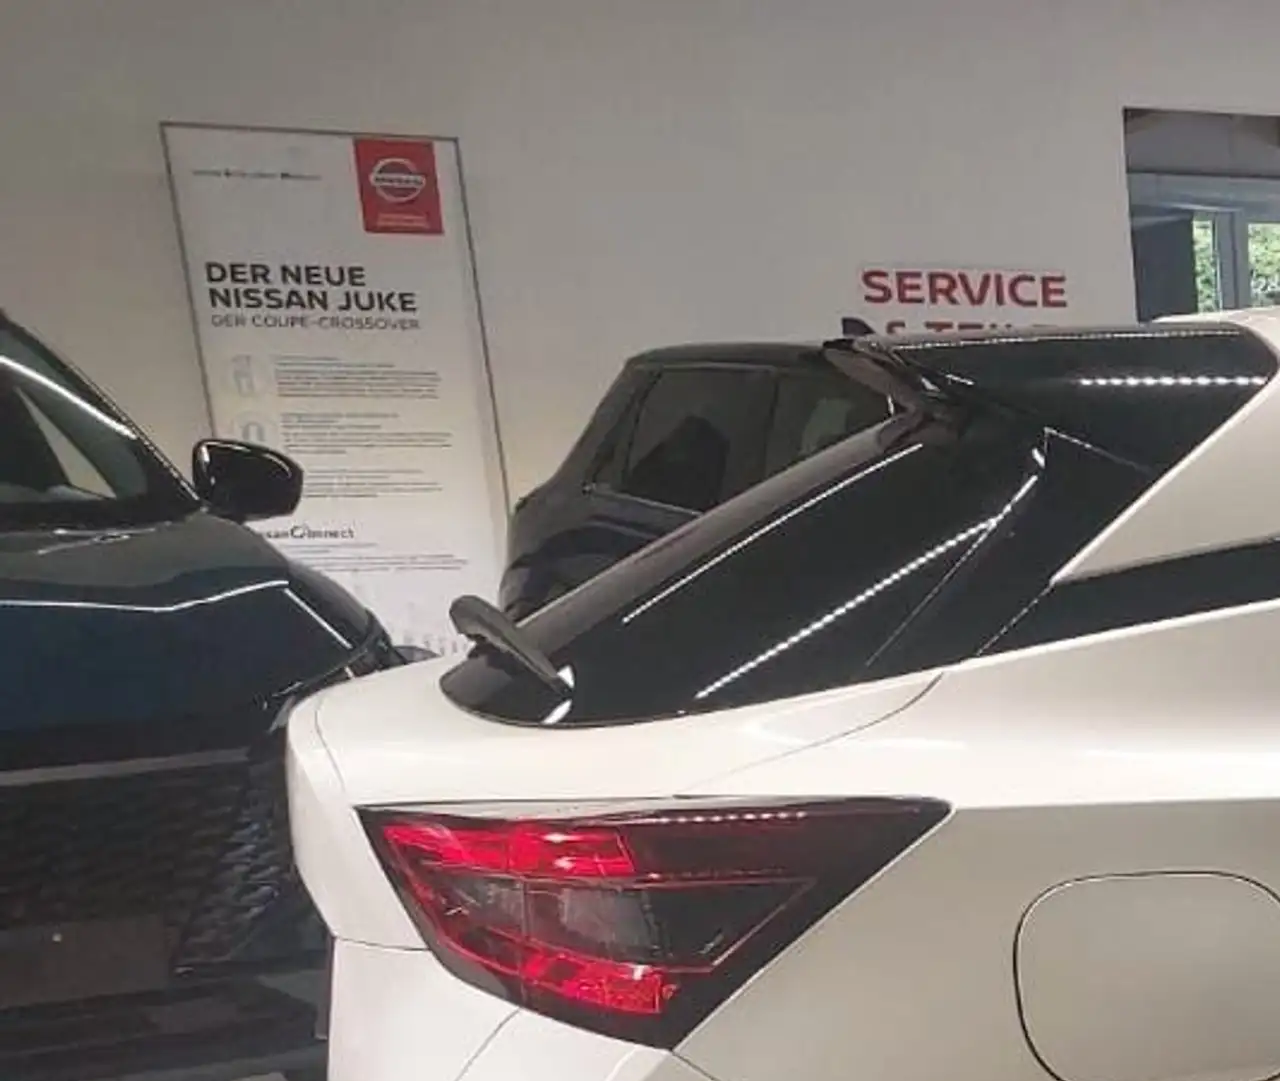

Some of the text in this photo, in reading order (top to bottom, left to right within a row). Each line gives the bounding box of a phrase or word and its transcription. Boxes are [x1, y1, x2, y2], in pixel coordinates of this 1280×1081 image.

[205, 262, 365, 287] DER NEUE
[209, 288, 418, 313] NISSAN JUKE
[861, 270, 1068, 308] SERVICE
[211, 314, 247, 328] DER
